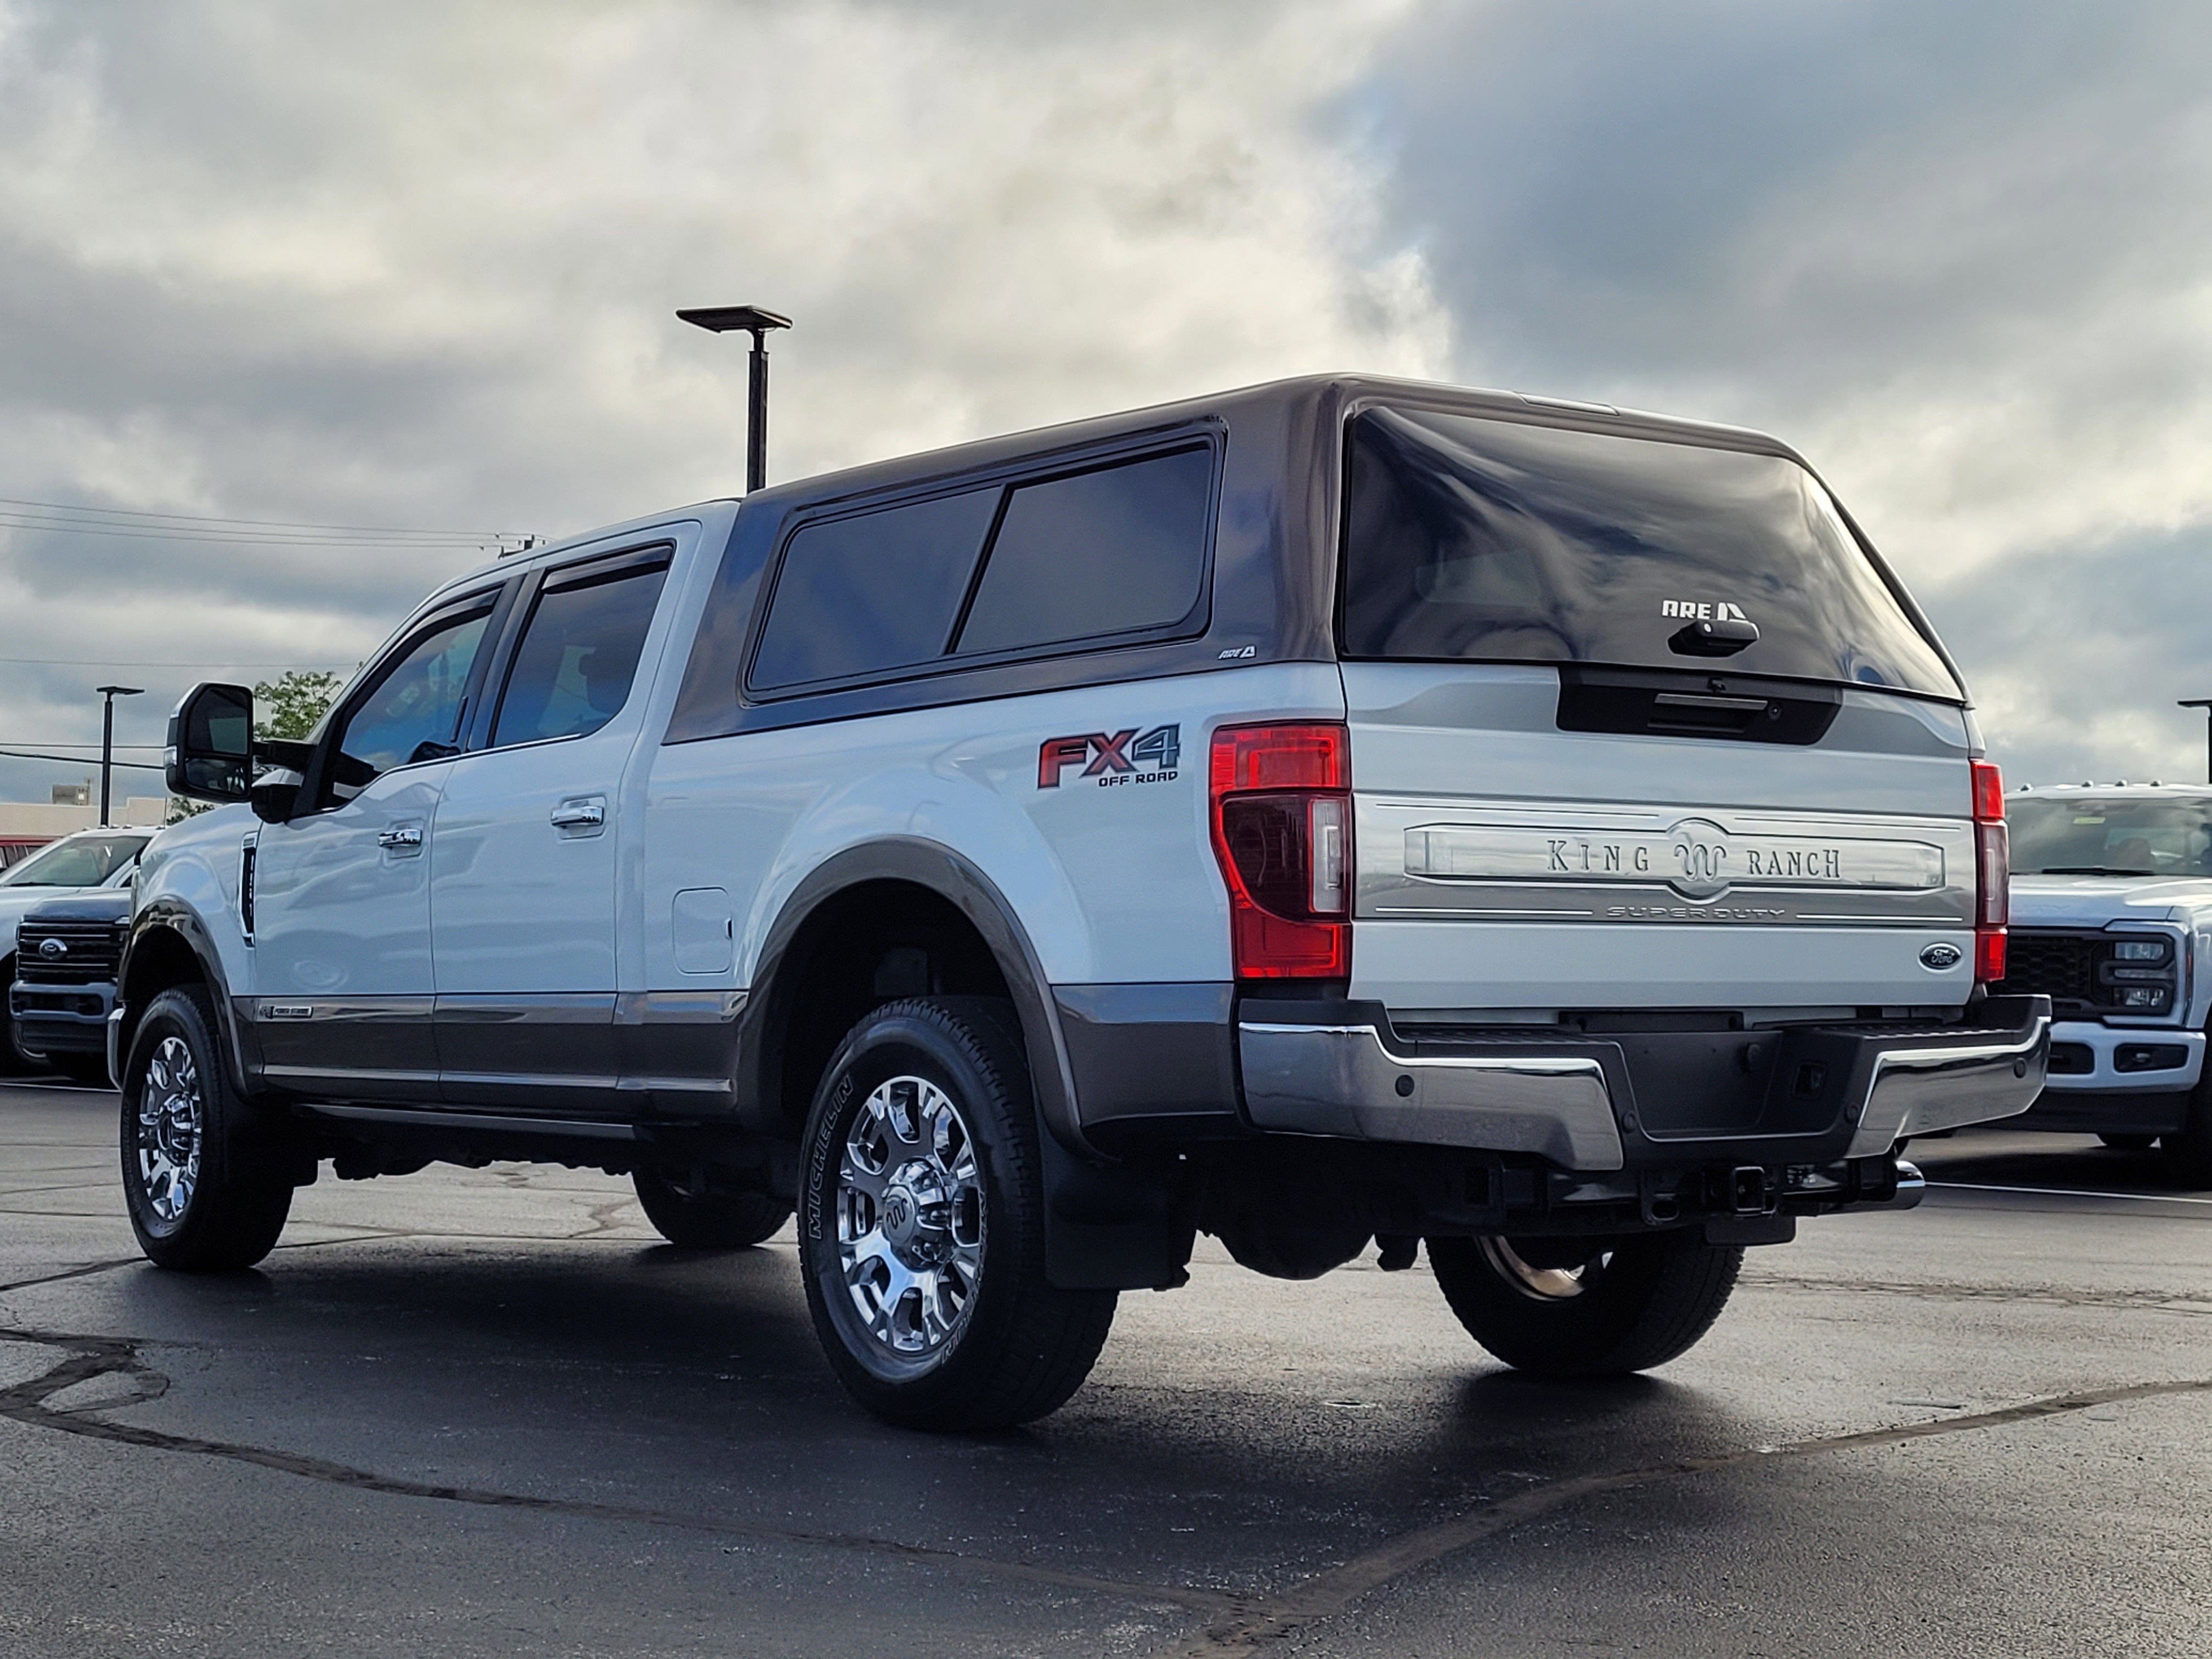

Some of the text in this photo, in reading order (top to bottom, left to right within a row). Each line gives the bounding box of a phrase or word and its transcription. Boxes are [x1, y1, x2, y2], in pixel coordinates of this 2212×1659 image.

[1662, 600, 1711, 620] ARE
[1037, 723, 1181, 789] FX4
[1098, 771, 1178, 787] OFF ROAD
[1547, 840, 1840, 878] KING RANCH
[1606, 906, 1785, 919] SUPER DUTY
[808, 1074, 854, 1240] MICHELIN
